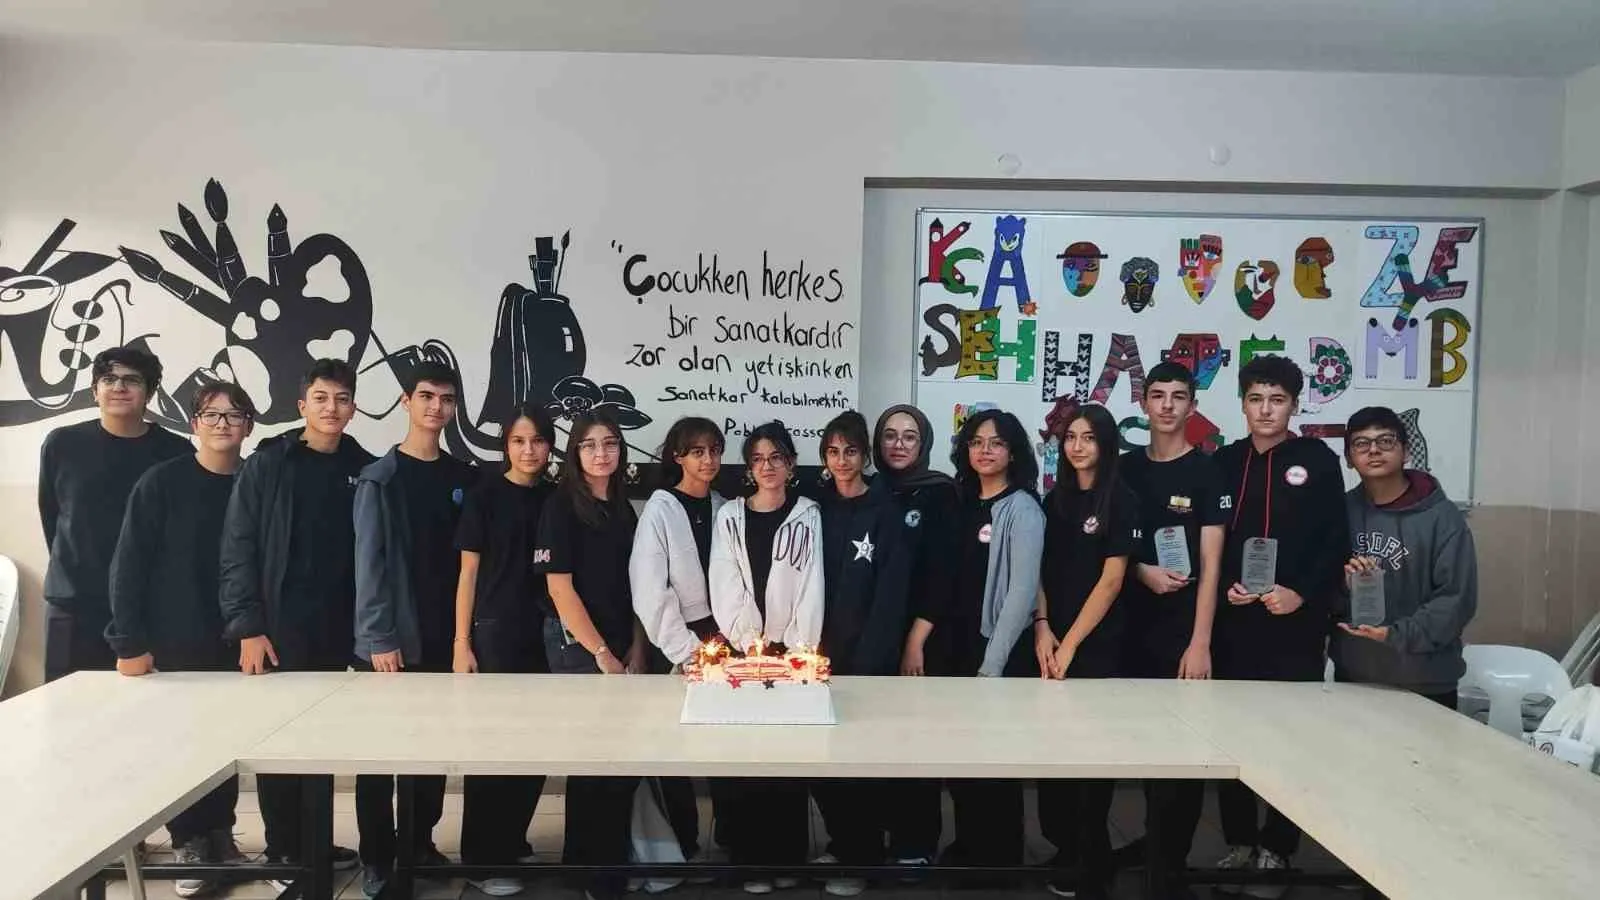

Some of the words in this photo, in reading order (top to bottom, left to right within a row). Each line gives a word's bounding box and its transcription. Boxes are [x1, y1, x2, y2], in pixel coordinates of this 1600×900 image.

[762, 250, 843, 302] herkes
[668, 304, 698, 338] bir
[679, 346, 731, 375] olan
